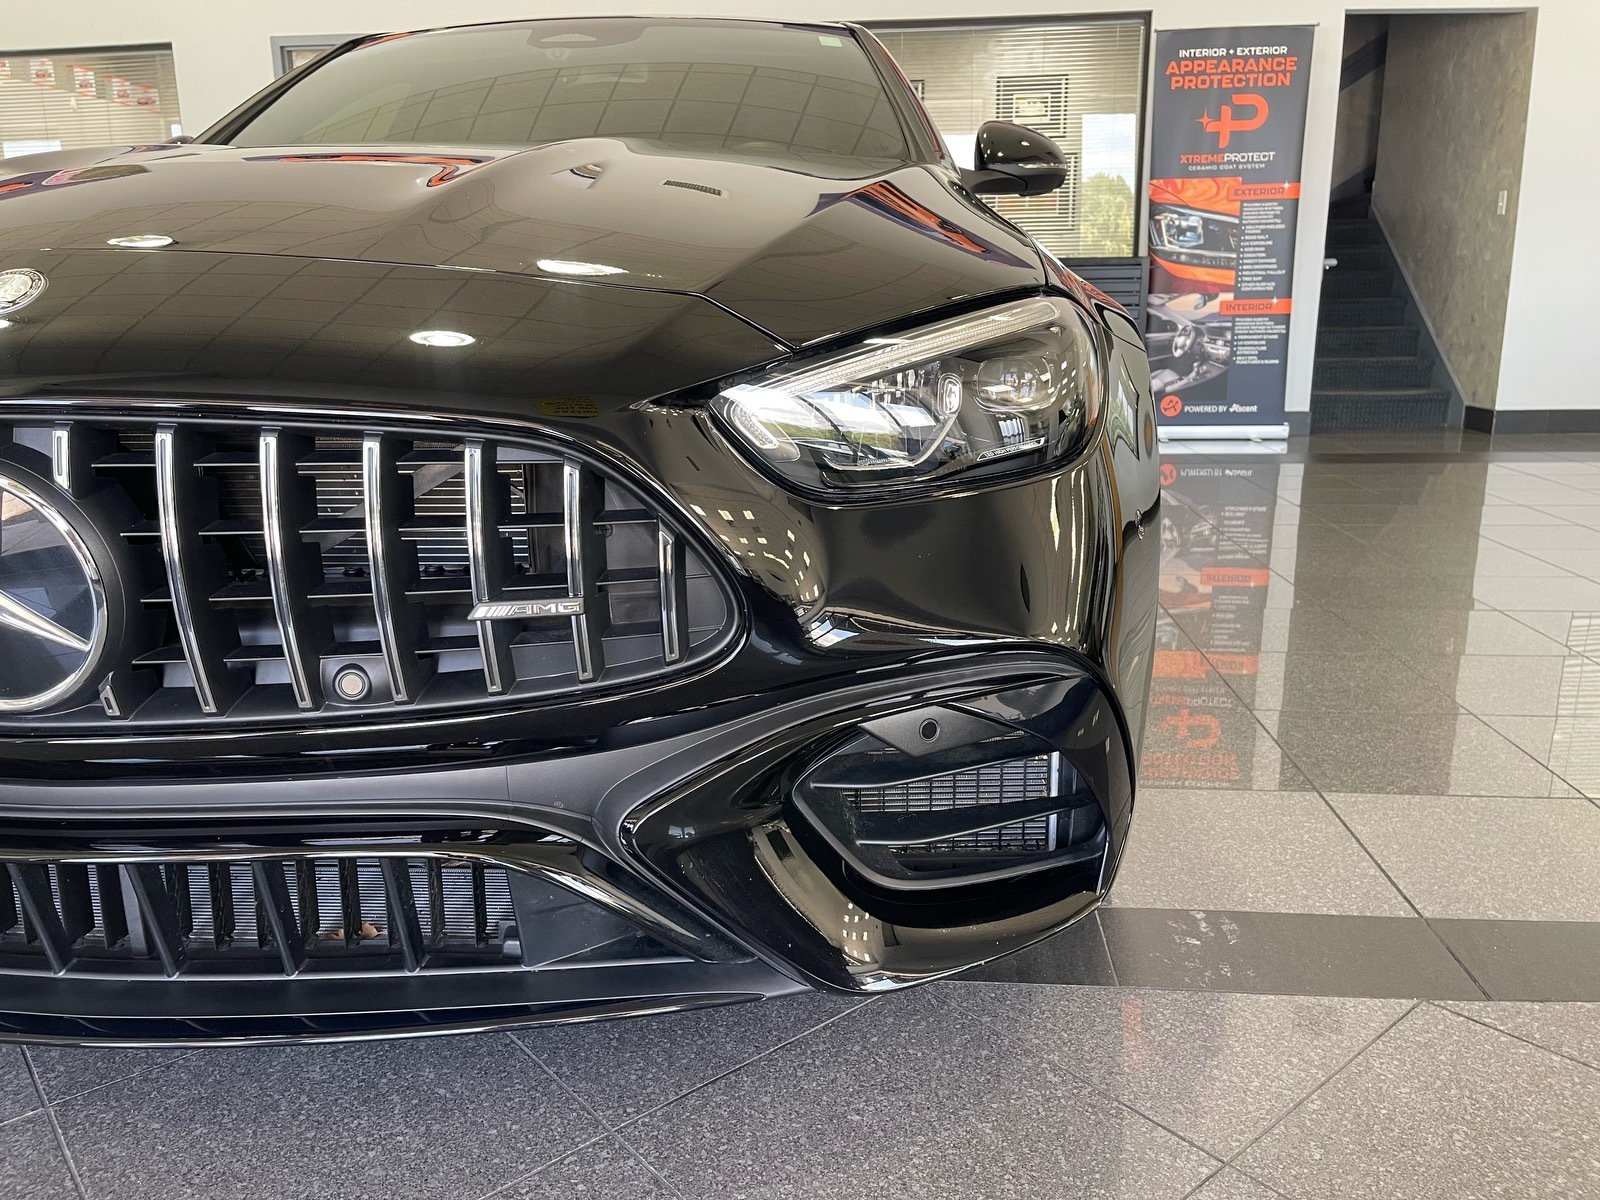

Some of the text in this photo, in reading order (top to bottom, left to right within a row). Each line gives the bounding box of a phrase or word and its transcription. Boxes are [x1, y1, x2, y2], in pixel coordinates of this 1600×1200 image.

[1179, 48, 1227, 58] INTERIOR
[1236, 46, 1288, 56] EXTERIOR
[1165, 56, 1298, 75] APPEARANCE
[1171, 72, 1291, 90] PROTECTION
[1180, 152, 1276, 164] XTREMEPROTECT
[1234, 187, 1286, 197] EXTERIOR
[1226, 303, 1273, 312] INTERIOR
[1184, 405, 1218, 413] POWERED
[1218, 405, 1228, 413] BY
[512, 601, 580, 615] AMG
